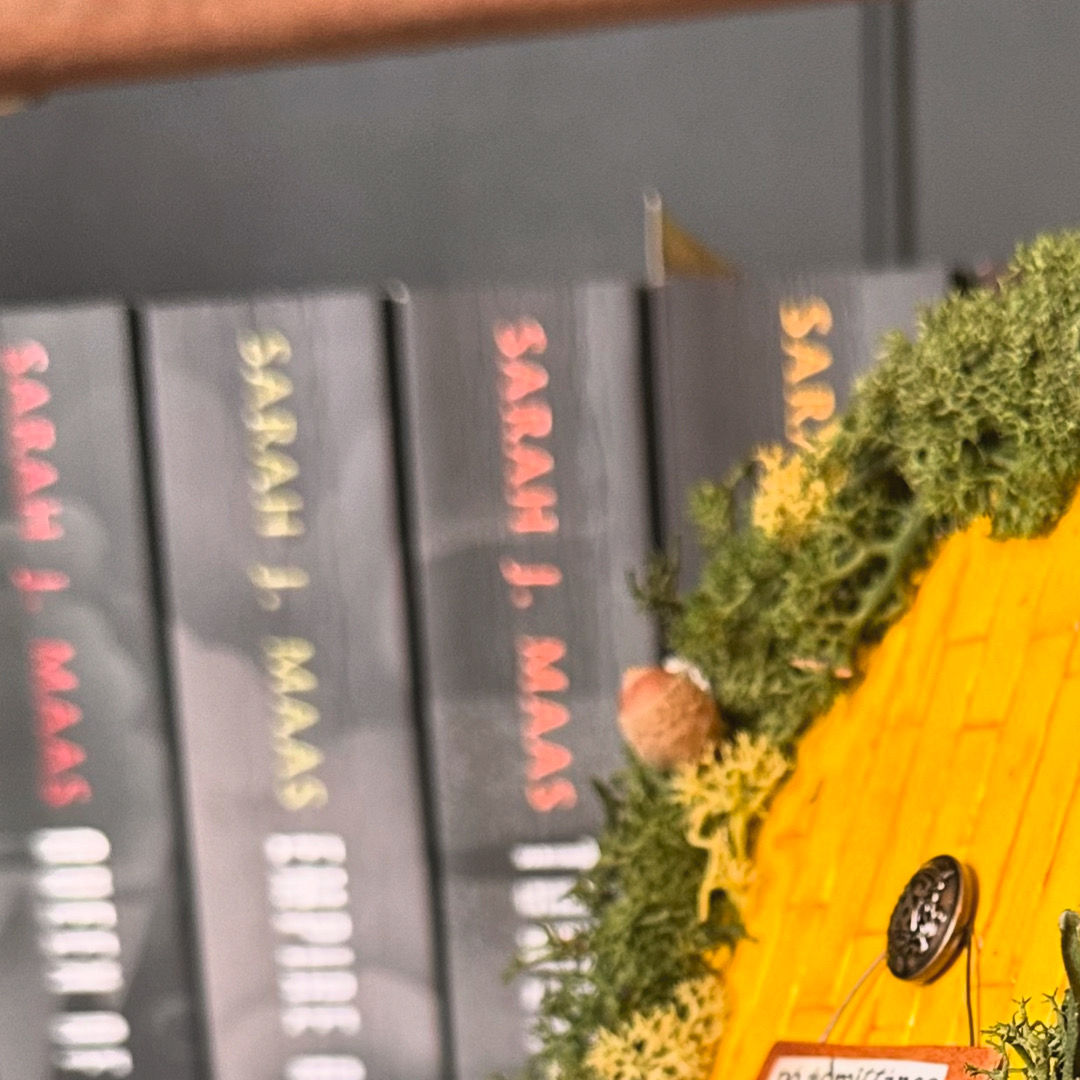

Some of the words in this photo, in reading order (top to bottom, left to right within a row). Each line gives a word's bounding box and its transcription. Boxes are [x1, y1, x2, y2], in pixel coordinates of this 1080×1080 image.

[0, 338, 65, 541] SARAH
[238, 328, 303, 538] SARAH
[494, 315, 559, 534] SARAH
[248, 562, 309, 611] J.
[500, 557, 563, 610] J.
[29, 637, 92, 809] MAAS
[262, 633, 329, 811] MAAS
[514, 634, 578, 812] MAAS
[264, 832, 363, 1035] EMPIRE
[50, 1010, 133, 1079] OF
